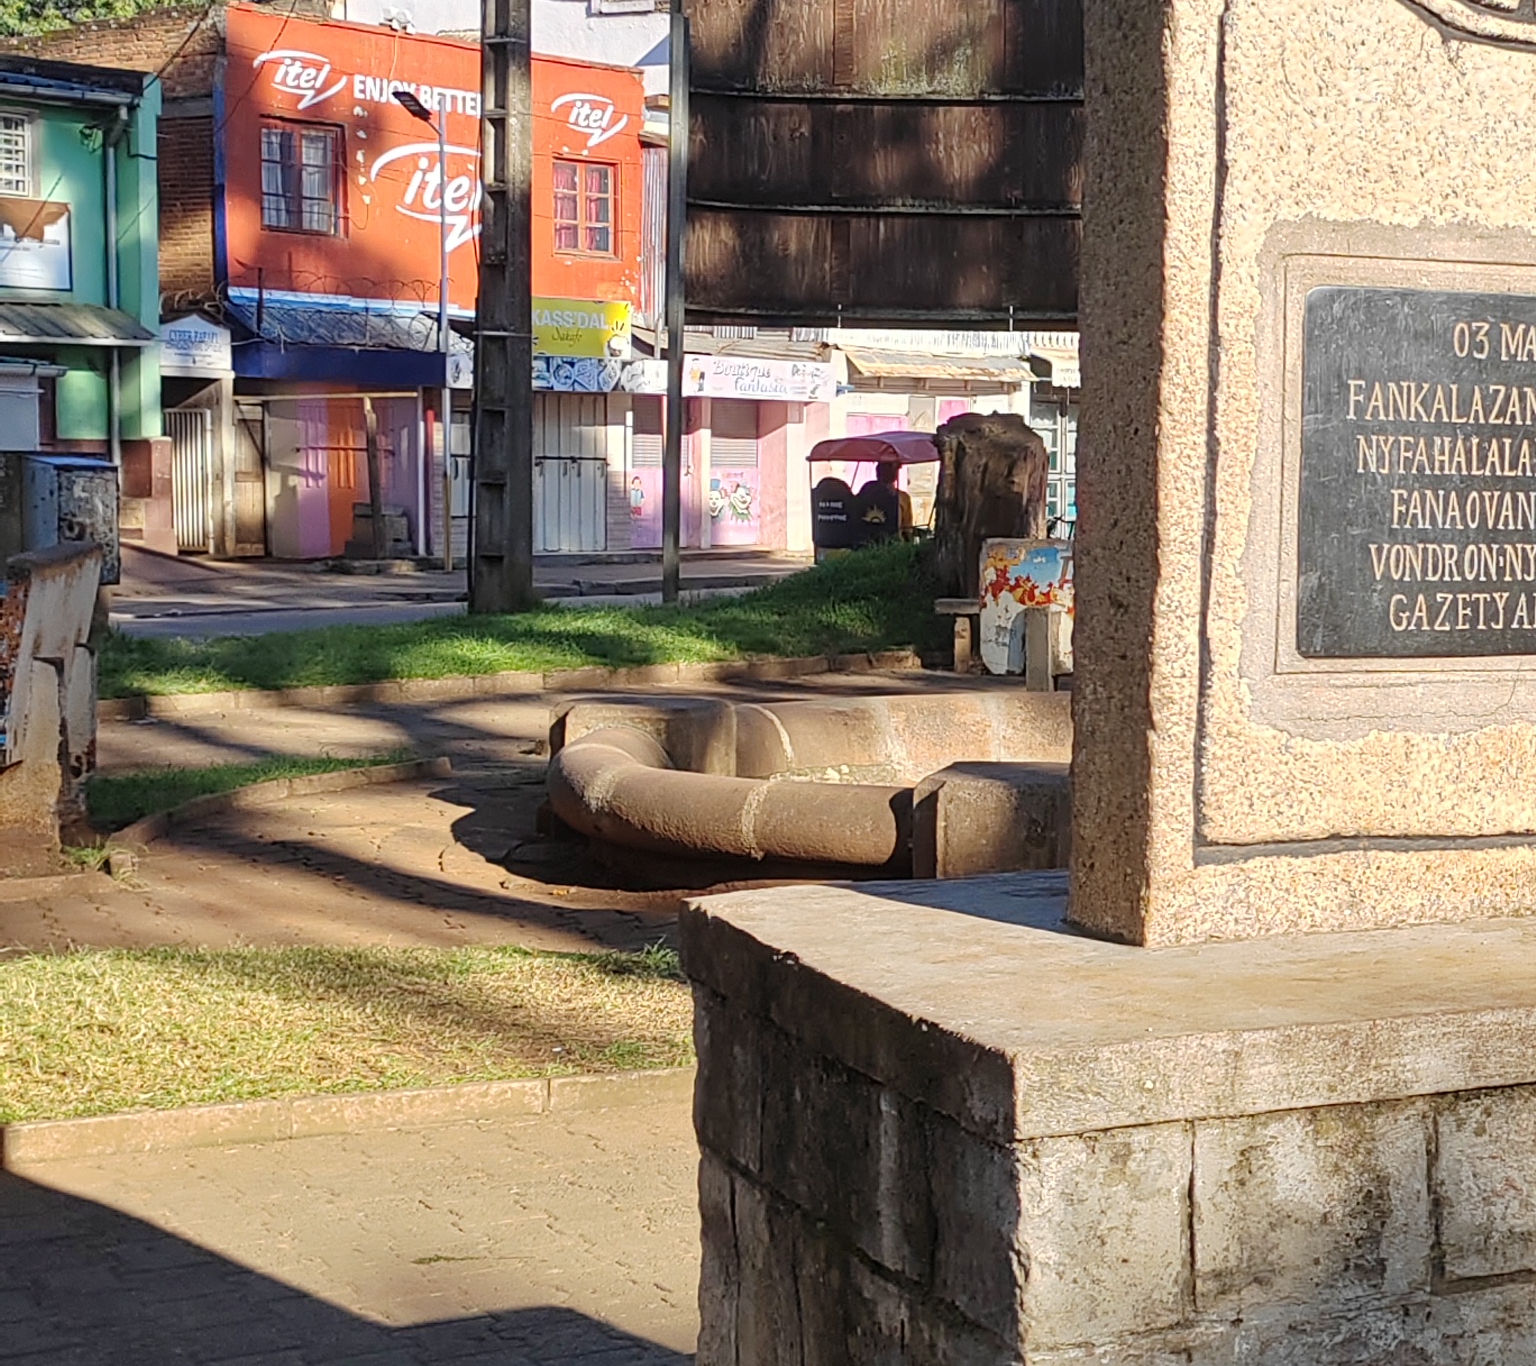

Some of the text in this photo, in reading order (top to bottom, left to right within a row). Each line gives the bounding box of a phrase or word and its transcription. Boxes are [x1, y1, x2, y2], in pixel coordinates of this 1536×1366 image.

[273, 57, 331, 89] itel
[568, 100, 615, 129] itel
[1453, 322, 1490, 360] 03
[1388, 591, 1509, 632] GAZETY
